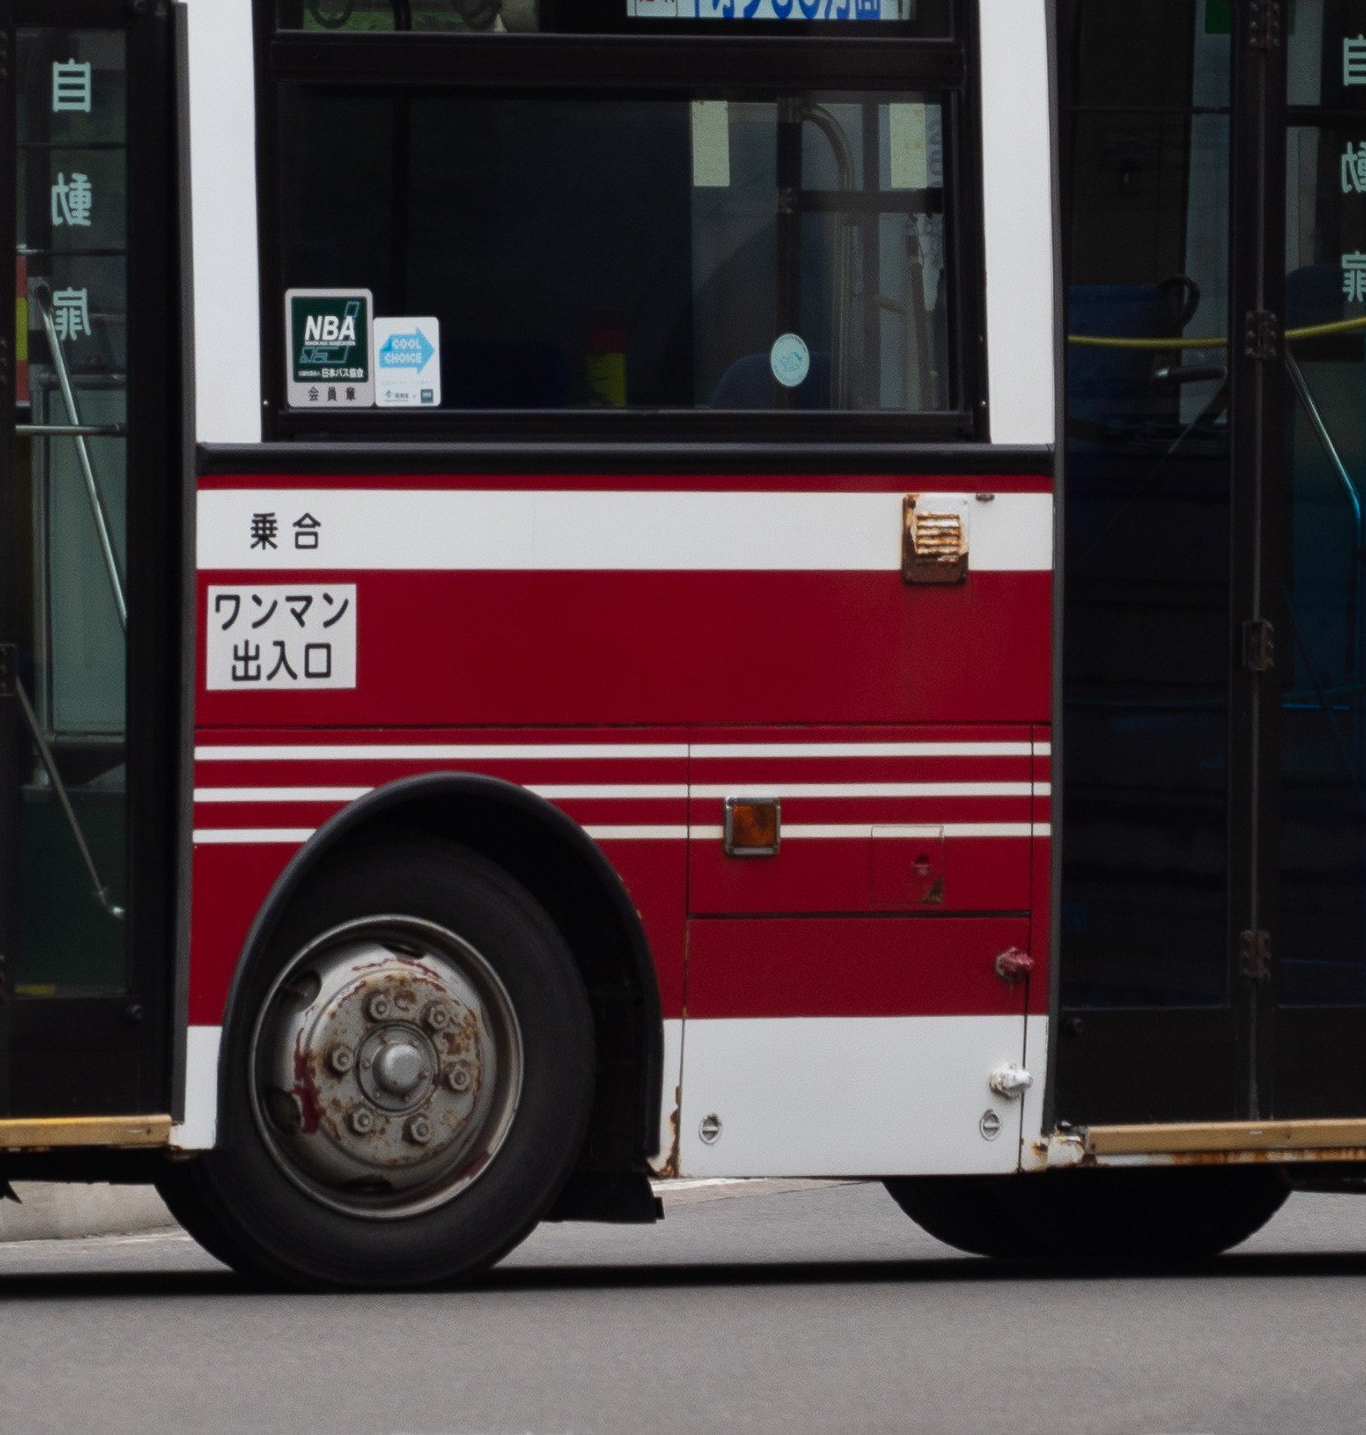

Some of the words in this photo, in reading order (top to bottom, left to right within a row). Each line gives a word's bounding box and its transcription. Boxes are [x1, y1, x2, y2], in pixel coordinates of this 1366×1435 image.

[304, 314, 356, 341] NBA
[392, 337, 422, 349] COOL
[384, 352, 422, 364] CHOICE
[250, 511, 322, 551] 乗合
[214, 591, 350, 631] ワンマン
[231, 638, 332, 682] 出入口
